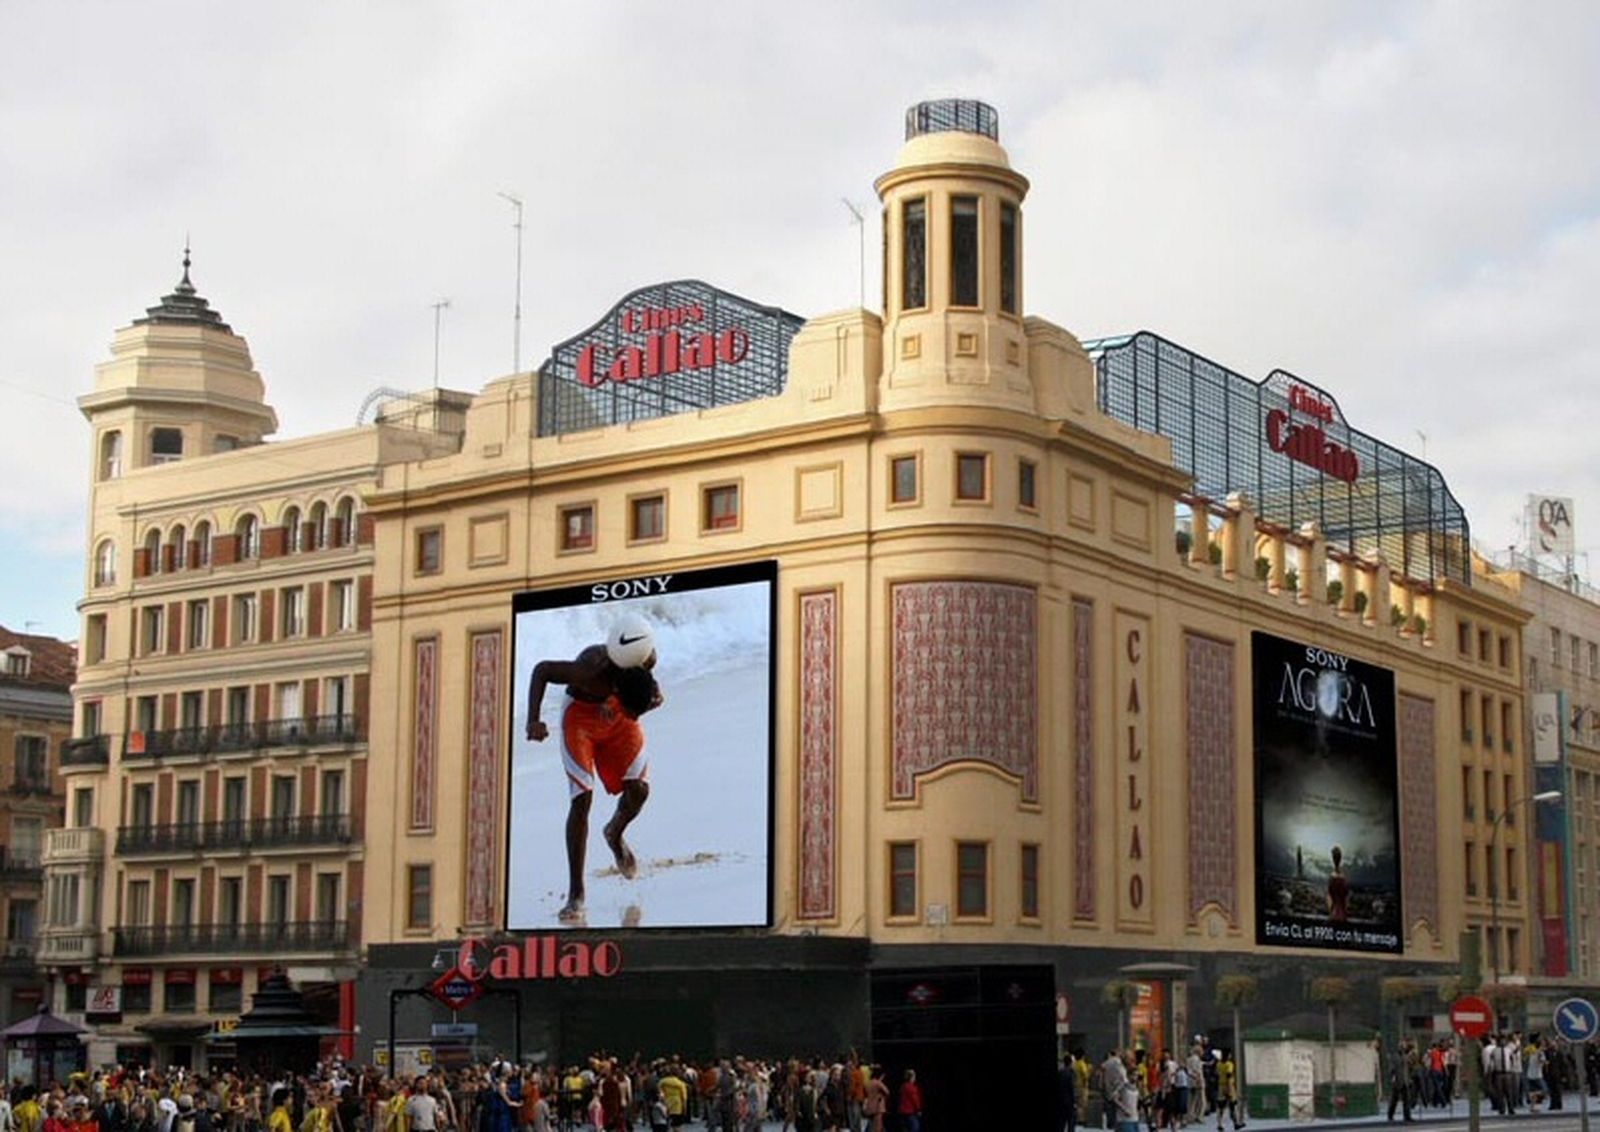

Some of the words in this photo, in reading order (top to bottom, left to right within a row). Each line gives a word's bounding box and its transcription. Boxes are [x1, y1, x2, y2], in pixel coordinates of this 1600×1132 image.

[622, 301, 704, 334] Cines
[575, 325, 749, 389] Callao
[1288, 384, 1334, 424] Cines
[1265, 408, 1359, 483] Callao
[591, 575, 673, 602] SONY
[1305, 647, 1349, 672] SONY
[1126, 629, 1144, 911] CALLAO
[458, 935, 622, 981] Callao
[1335, 930, 1352, 942] con
[1364, 932, 1398, 948] mensaje
